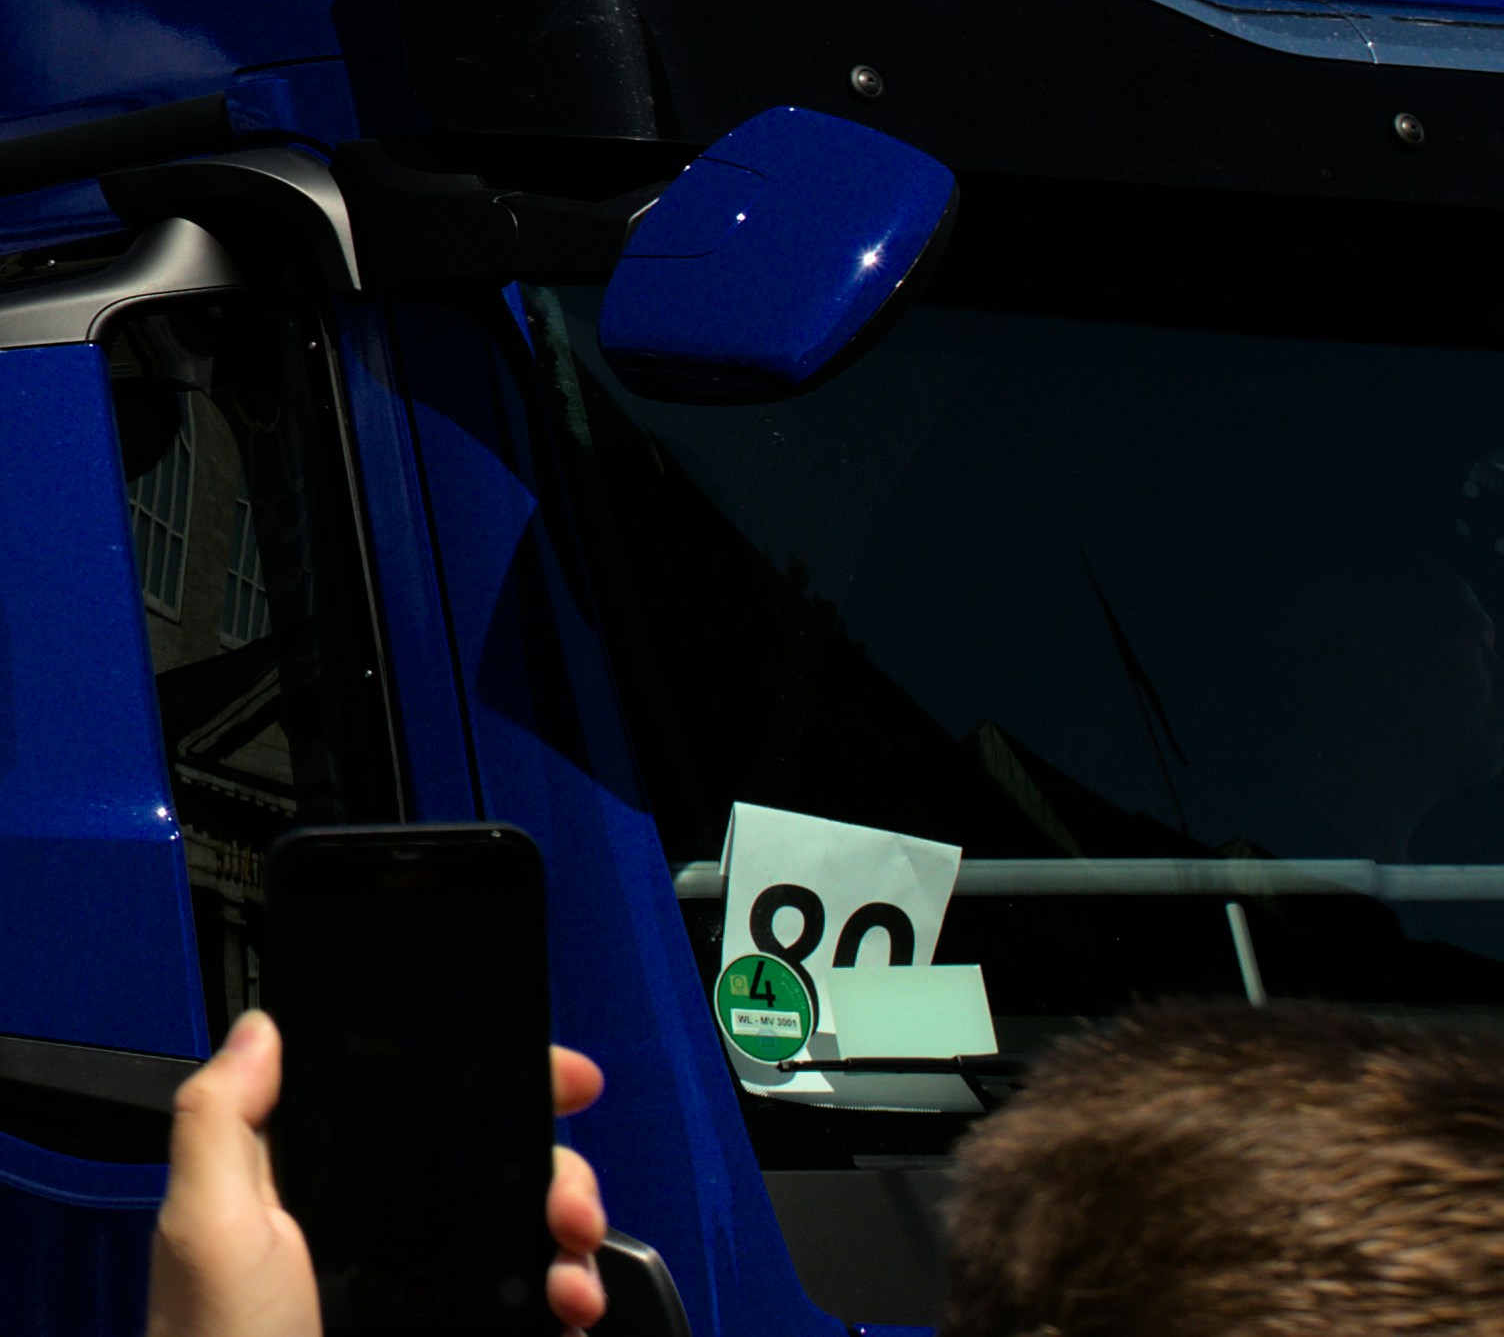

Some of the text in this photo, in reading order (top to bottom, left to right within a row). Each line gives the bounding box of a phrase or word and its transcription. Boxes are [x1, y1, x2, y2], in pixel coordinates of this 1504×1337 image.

[749, 960, 776, 1008] 4
[737, 1015, 753, 1025] WL
[760, 1016, 775, 1026] MV
